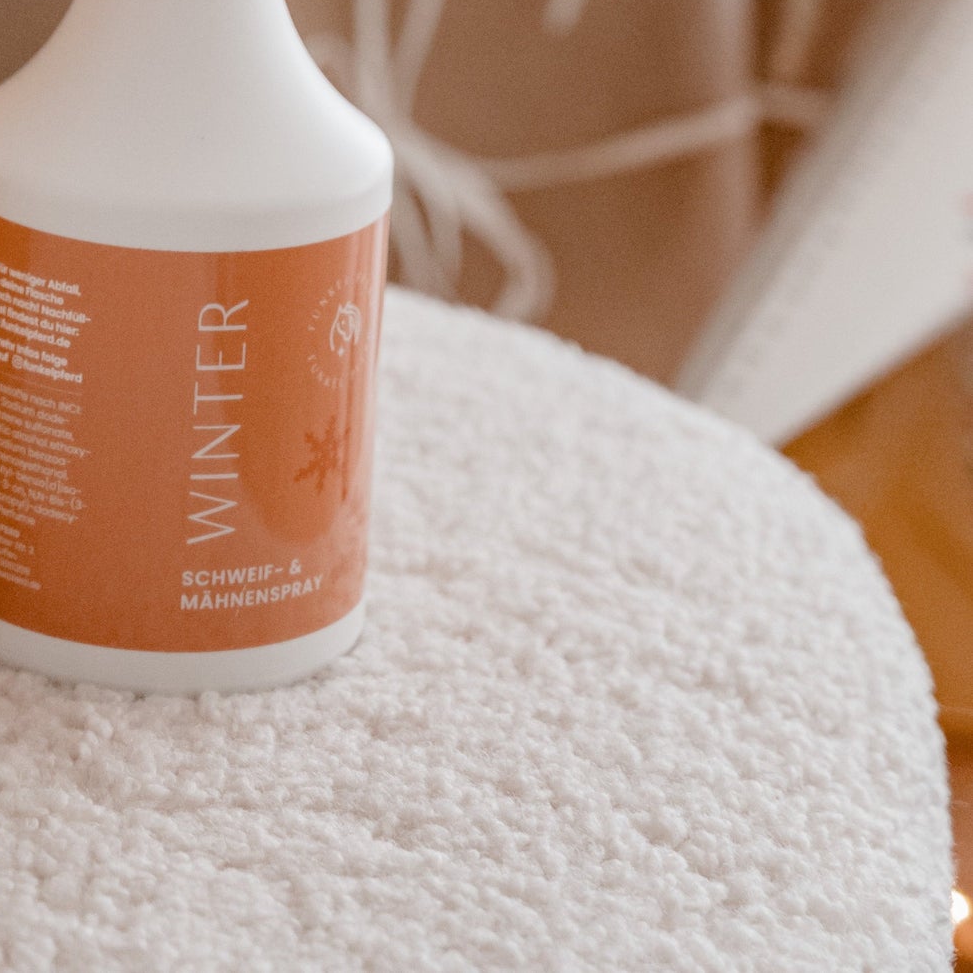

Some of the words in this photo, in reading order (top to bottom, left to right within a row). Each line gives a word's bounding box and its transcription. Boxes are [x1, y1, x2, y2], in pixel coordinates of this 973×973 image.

[48, 278, 81, 297] Abfall,
[39, 317, 54, 331] du
[186, 298, 250, 545] WINTER
[181, 563, 284, 587] SCHWEIF-
[289, 557, 302, 575] &
[180, 573, 324, 611] MÄHNENSPRAY
